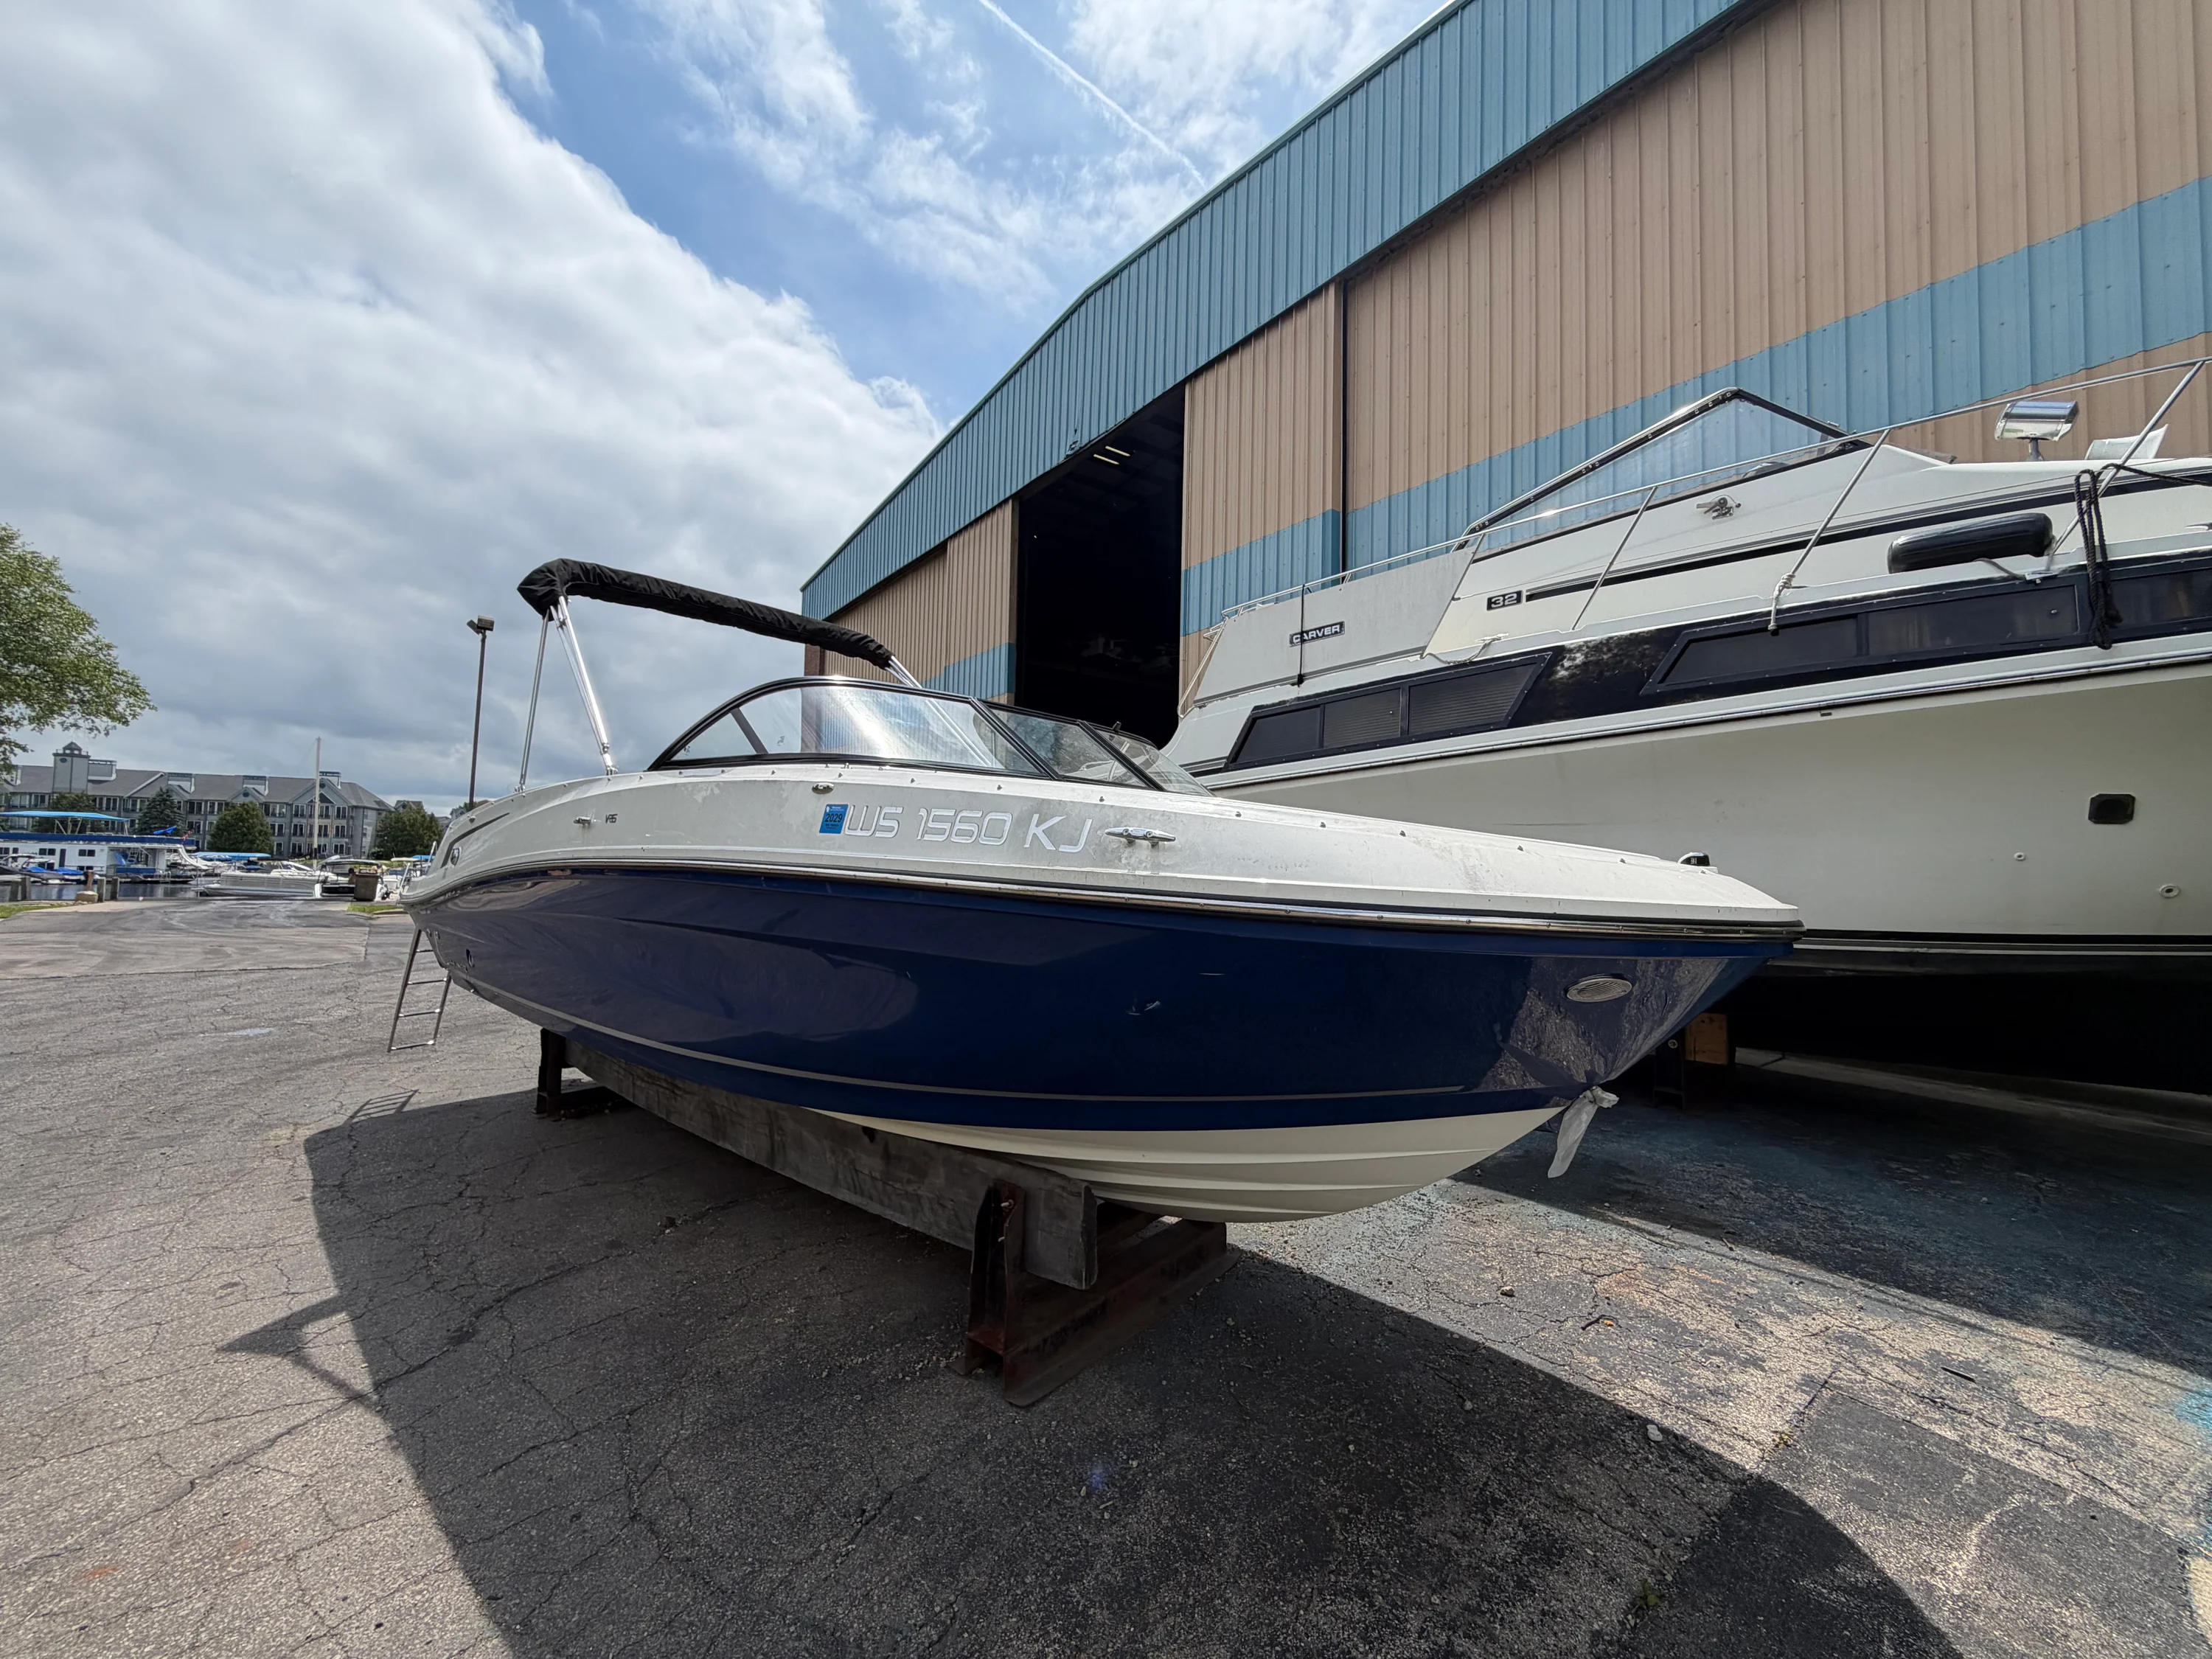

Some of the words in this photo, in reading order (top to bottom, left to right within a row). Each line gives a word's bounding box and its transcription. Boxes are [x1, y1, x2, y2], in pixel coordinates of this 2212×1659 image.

[1491, 593, 1517, 608] 32
[824, 813, 843, 823] 2029
[844, 805, 904, 838] WS
[916, 808, 1013, 846] 1560
[1023, 813, 1093, 853] KJ
